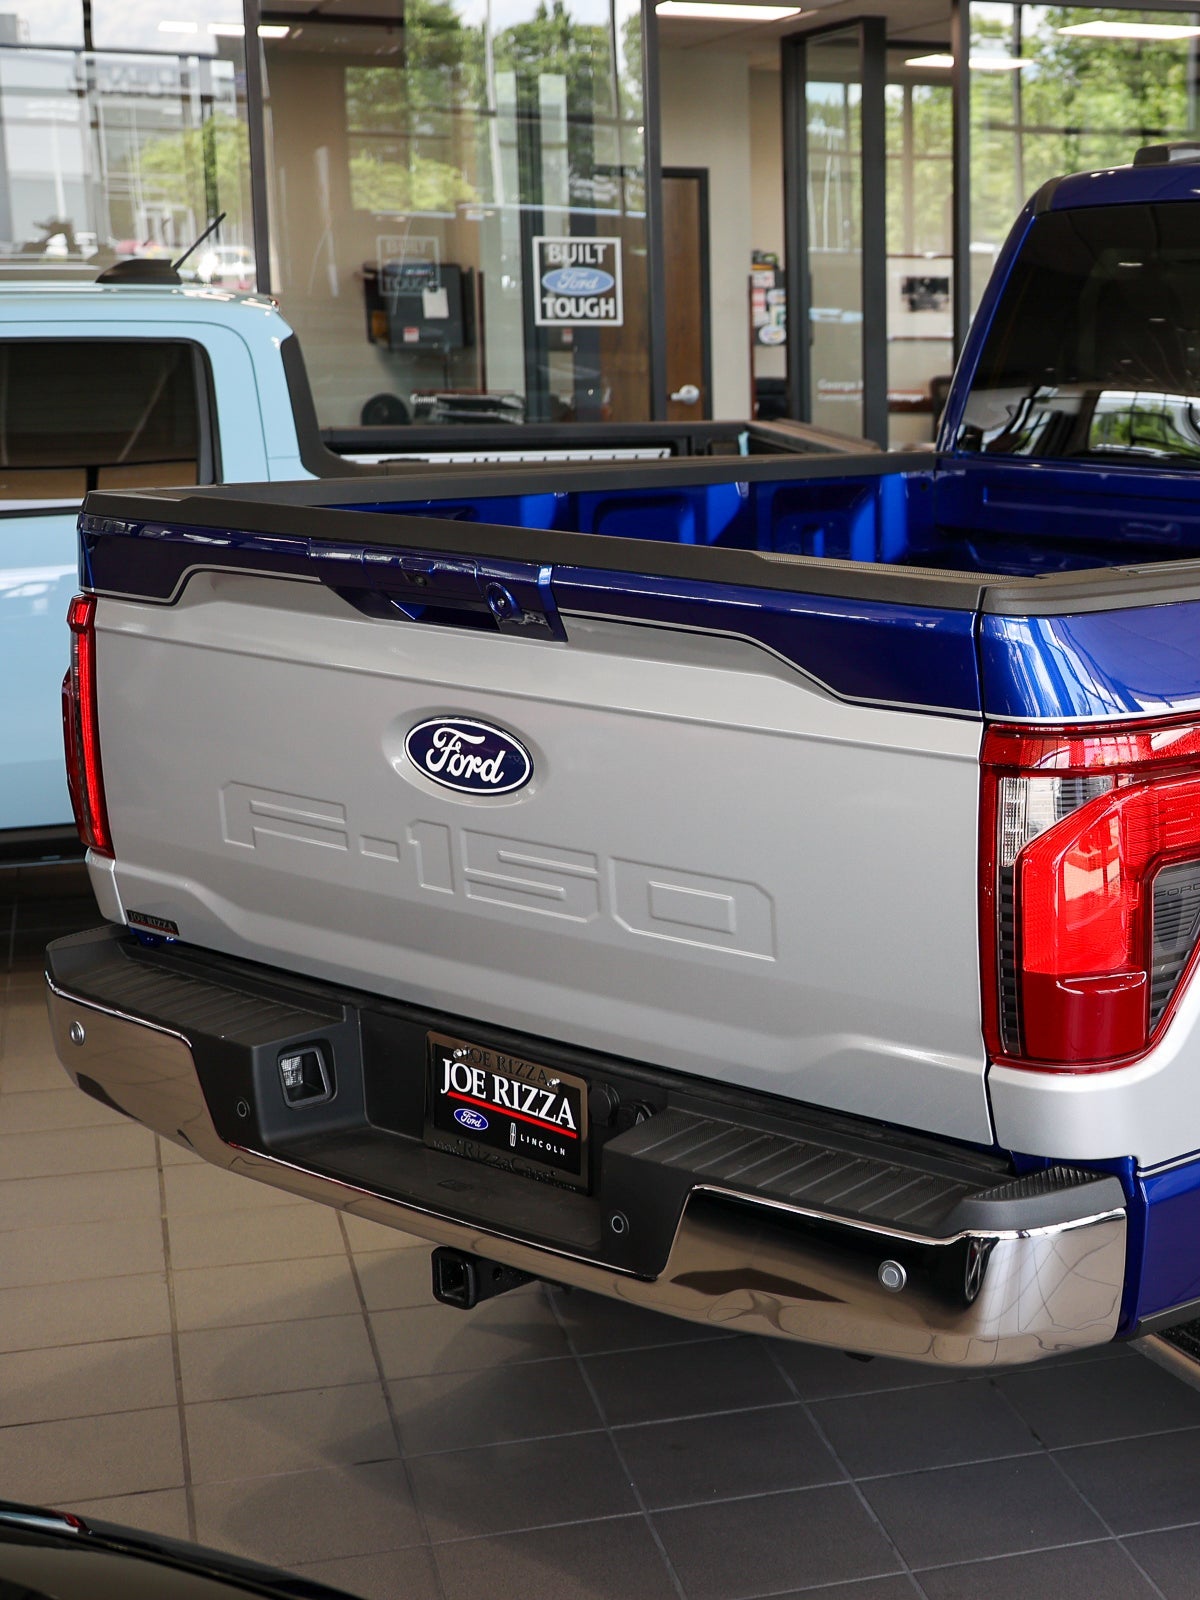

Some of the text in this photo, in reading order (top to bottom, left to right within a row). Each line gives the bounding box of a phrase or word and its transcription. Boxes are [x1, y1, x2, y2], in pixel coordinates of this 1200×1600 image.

[547, 244, 607, 263] BUILT
[556, 271, 599, 290] Ford
[542, 298, 615, 318] TOUGH
[426, 727, 506, 784] Ford
[219, 780, 776, 962] F-150
[496, 1055, 549, 1087] RIZZA
[440, 1058, 577, 1131] JOE RIZZA
[460, 1110, 483, 1128] Ford
[520, 1133, 566, 1156] LINCOLN
